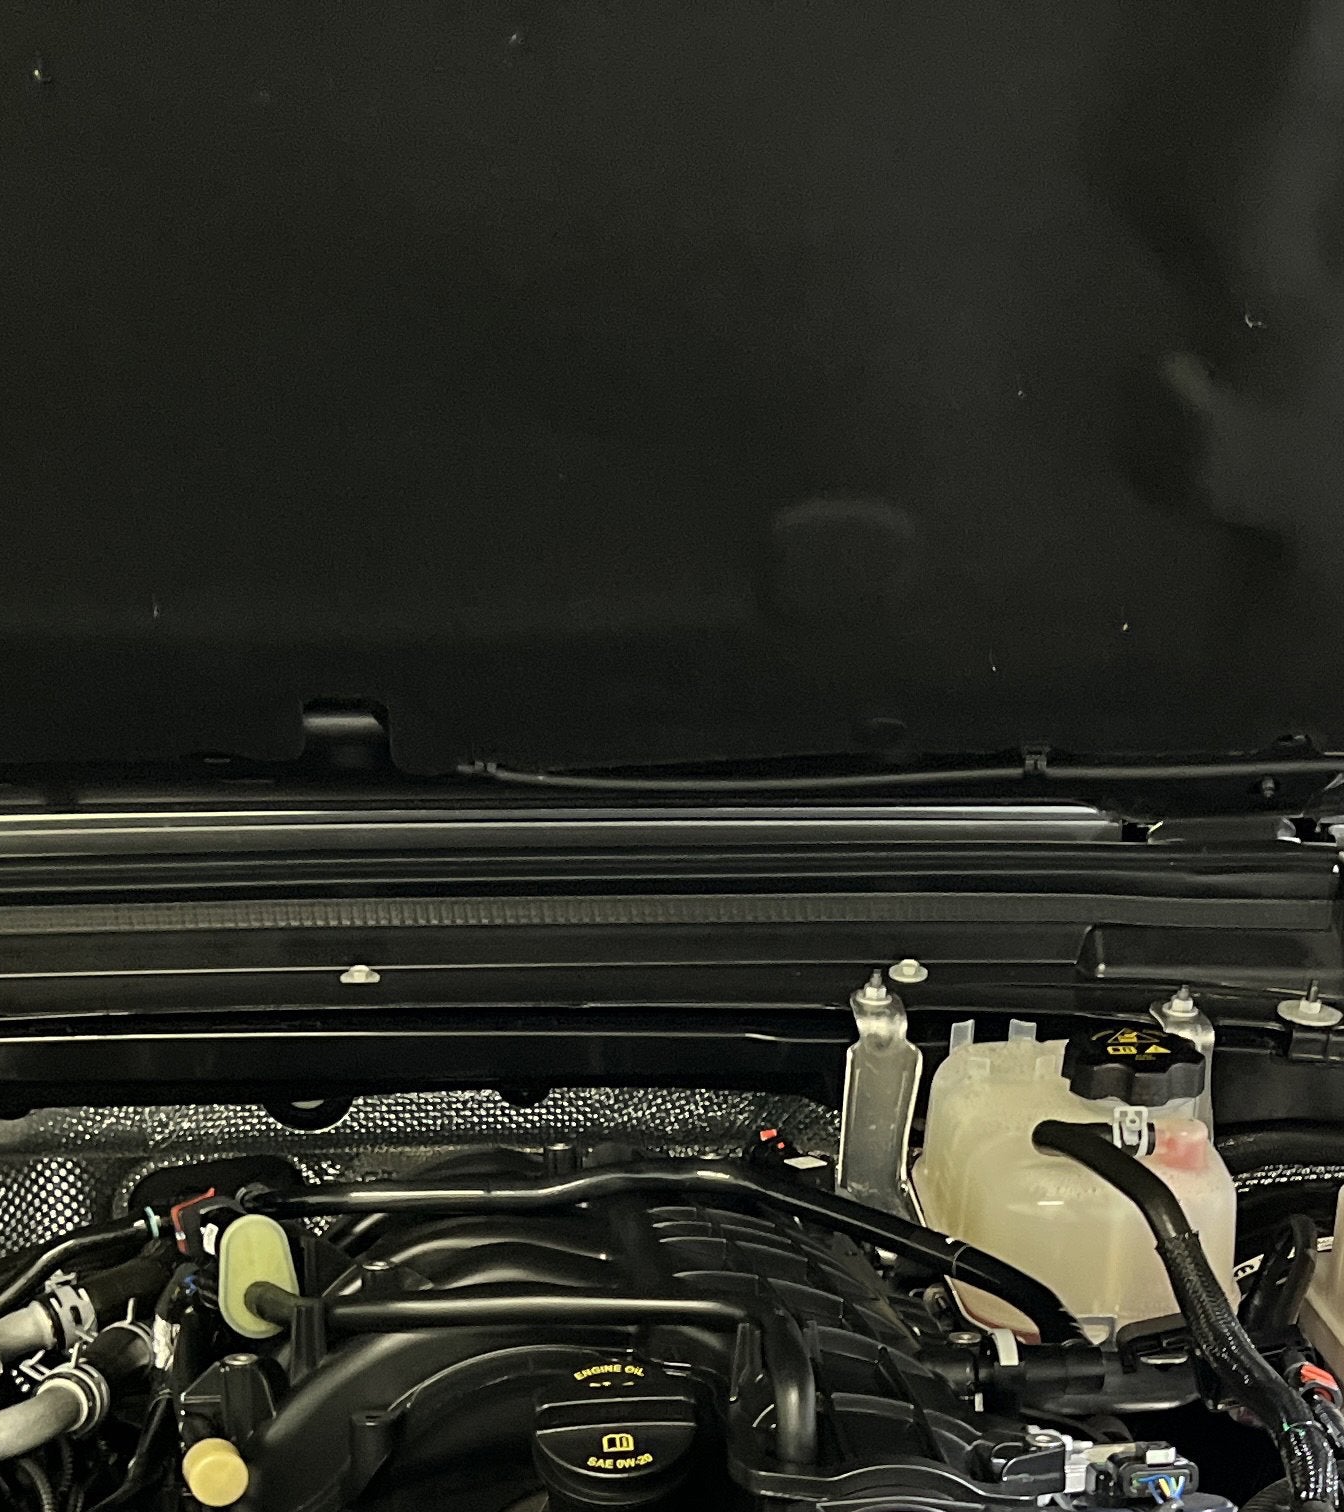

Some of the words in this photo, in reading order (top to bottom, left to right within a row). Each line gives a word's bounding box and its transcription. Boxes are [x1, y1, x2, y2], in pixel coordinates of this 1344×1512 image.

[574, 1364, 622, 1380] ENGINE
[624, 1365, 645, 1377] OIL
[587, 1456, 614, 1469] SAE
[616, 1453, 653, 1469] 0W-20
